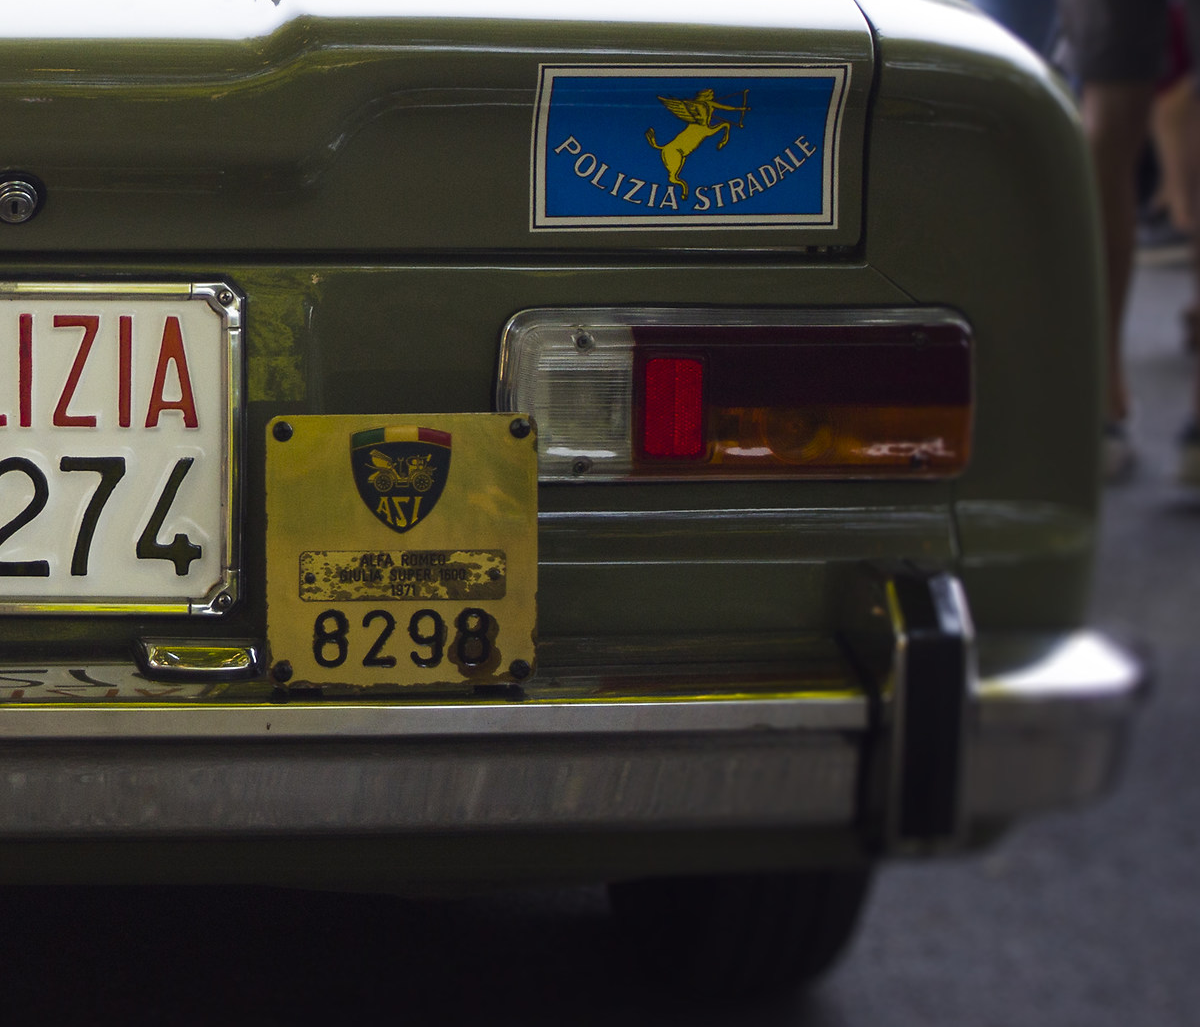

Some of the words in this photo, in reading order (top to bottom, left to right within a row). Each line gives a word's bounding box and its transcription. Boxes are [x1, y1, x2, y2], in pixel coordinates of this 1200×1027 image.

[554, 136, 679, 210] POLIZIA
[694, 136, 817, 210] STRADALE
[376, 496, 423, 527] ASI
[339, 568, 383, 582] GIULIA
[390, 568, 432, 582] SUPER
[439, 568, 467, 581] 1600
[360, 553, 394, 567] ALFA
[401, 553, 447, 567] ROMEO
[312, 607, 490, 668] 8298
